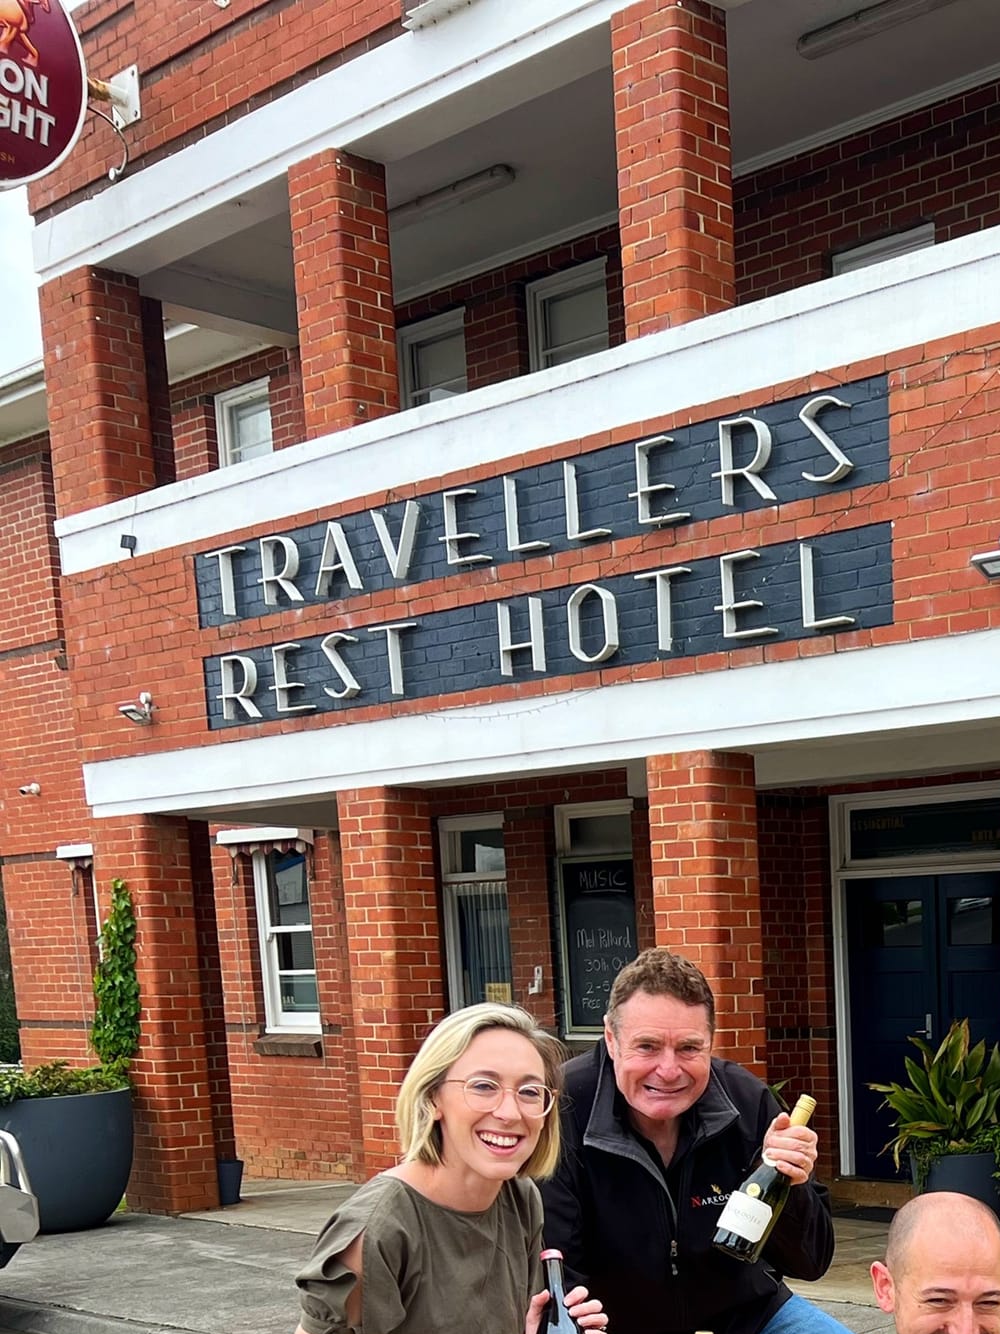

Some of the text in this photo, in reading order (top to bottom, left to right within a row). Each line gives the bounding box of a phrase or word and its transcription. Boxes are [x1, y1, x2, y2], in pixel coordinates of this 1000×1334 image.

[203, 395, 855, 616] TRAVELLERS
[216, 542, 856, 721] REST HOTEL
[579, 870, 628, 889] MUSIC
